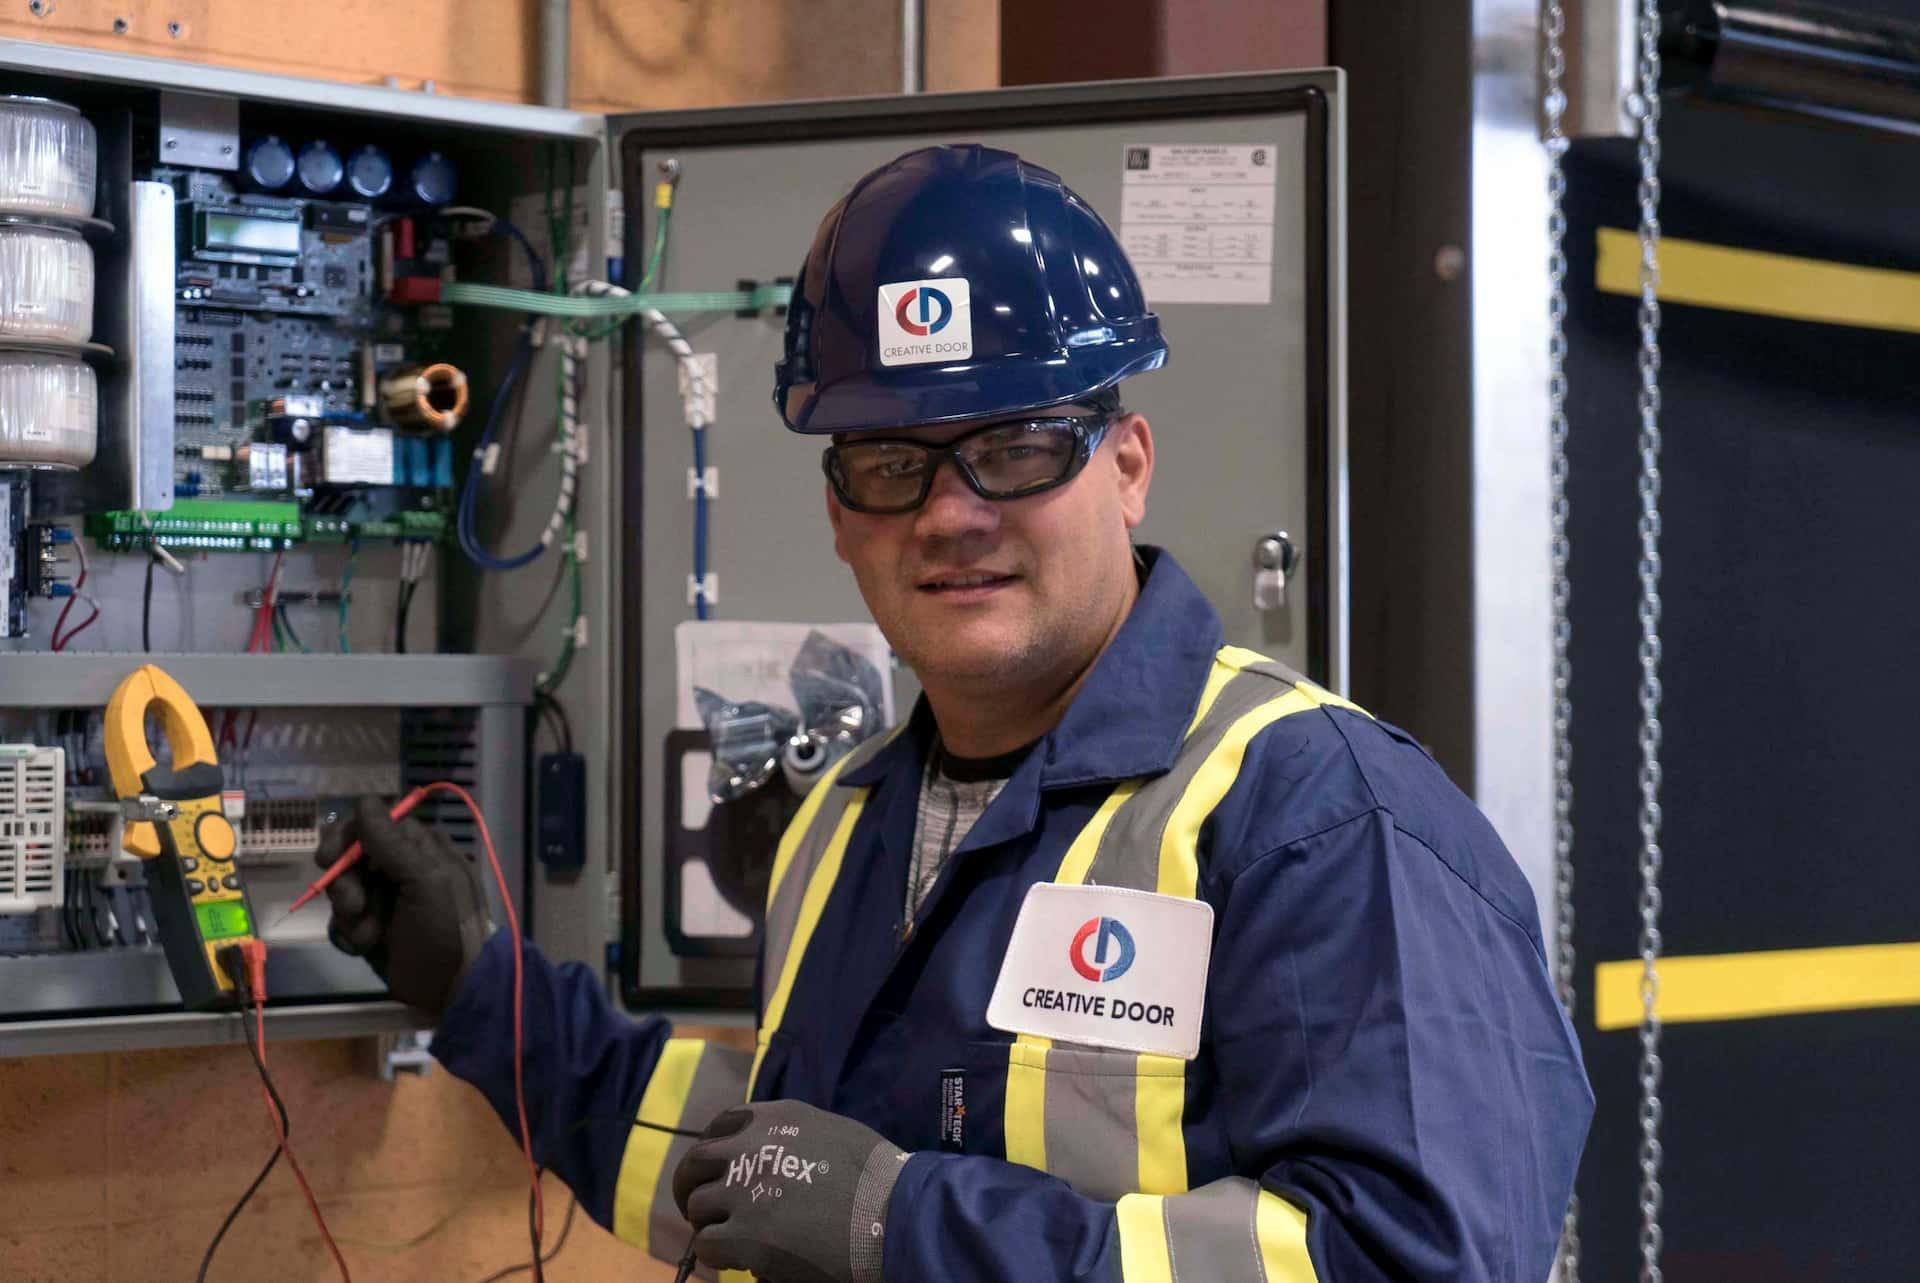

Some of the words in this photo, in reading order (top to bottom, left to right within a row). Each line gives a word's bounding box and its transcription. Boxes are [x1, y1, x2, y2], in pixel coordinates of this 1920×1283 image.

[884, 344, 932, 358] CREATIVE
[936, 342, 968, 353] DOOR
[1022, 987, 1105, 1017] CREATIVE
[1111, 999, 1175, 1027] DOOR
[954, 1077, 963, 1105] STAR
[952, 1114, 963, 1142] TECH
